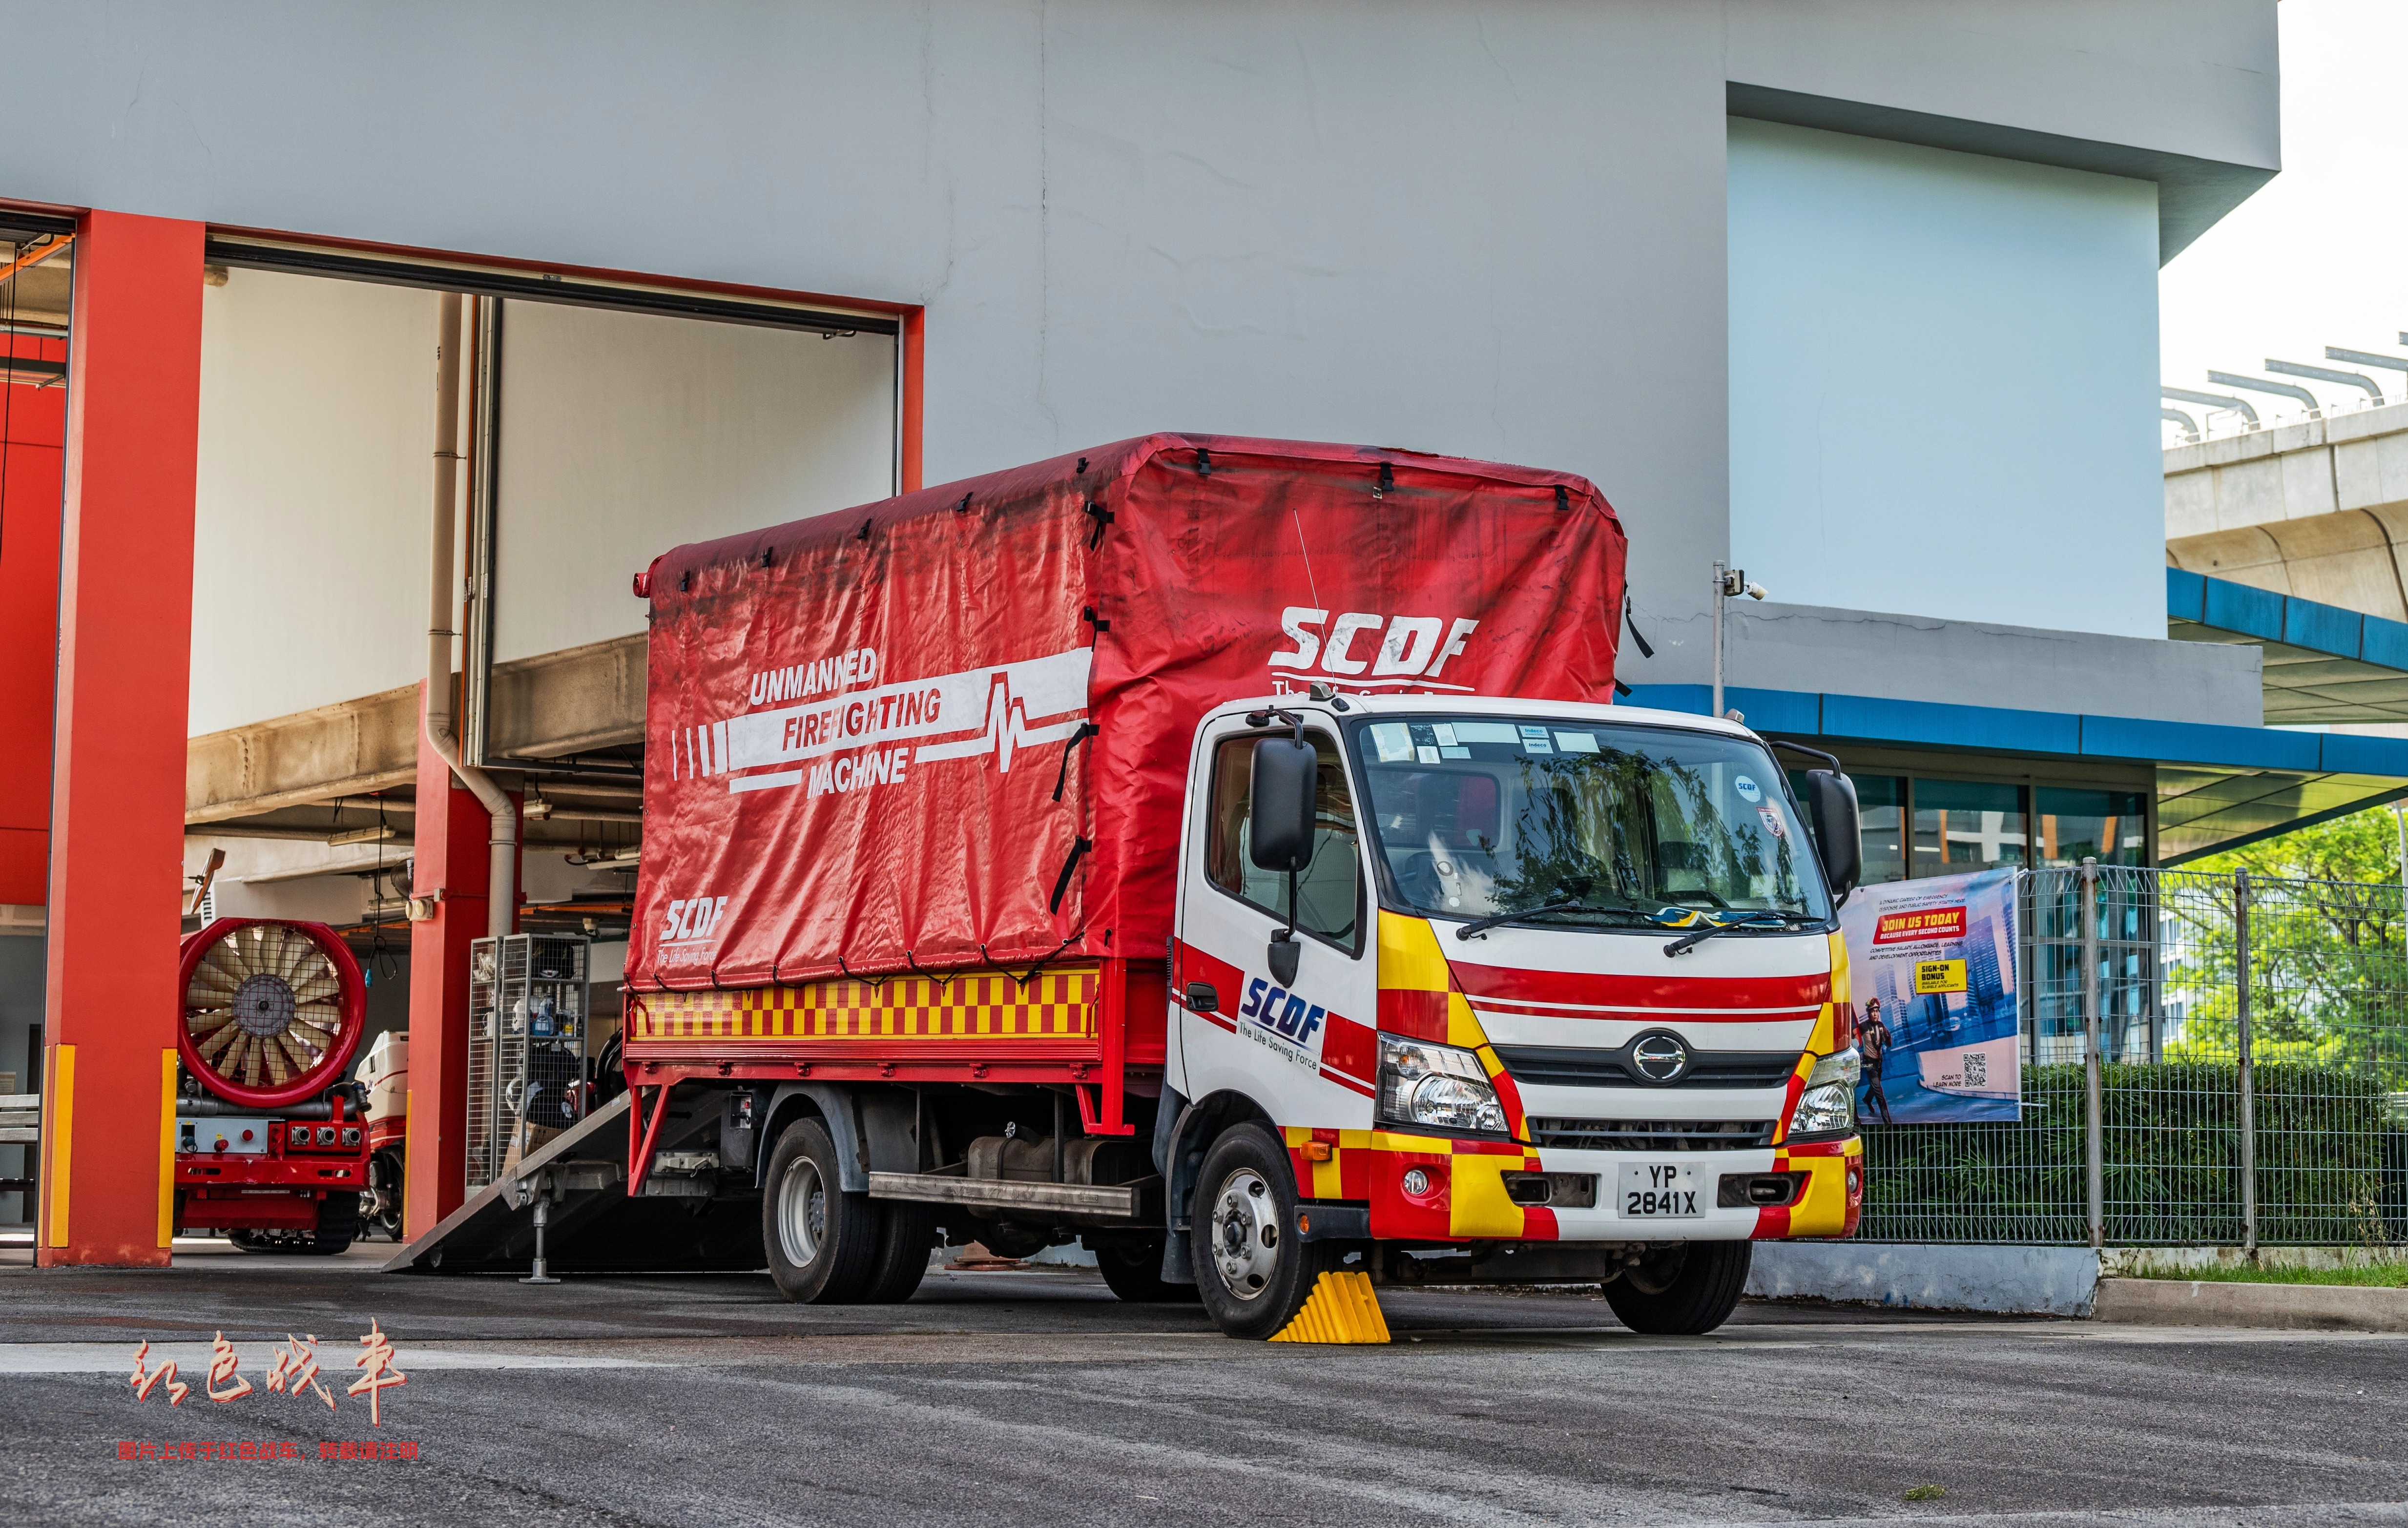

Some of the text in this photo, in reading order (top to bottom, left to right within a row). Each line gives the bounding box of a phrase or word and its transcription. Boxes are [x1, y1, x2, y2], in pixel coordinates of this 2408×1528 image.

[1267, 606, 1480, 677] SCDF
[750, 647, 877, 705] UNMANNED
[782, 688, 941, 751] FIREFIGHTING
[806, 748, 910, 799] MACHINE
[659, 896, 728, 941] SCDF
[1882, 912, 1960, 931] JOIN US TODAY
[657, 947, 716, 965] The Life Saving Force
[1921, 964, 1949, 972] SIGN-ON
[1241, 977, 1326, 1043] SCDF
[1240, 1021, 1317, 1070] The Life Saving Force
[1649, 1165, 1677, 1188] YP
[1627, 1191, 1697, 1214] 2841X
